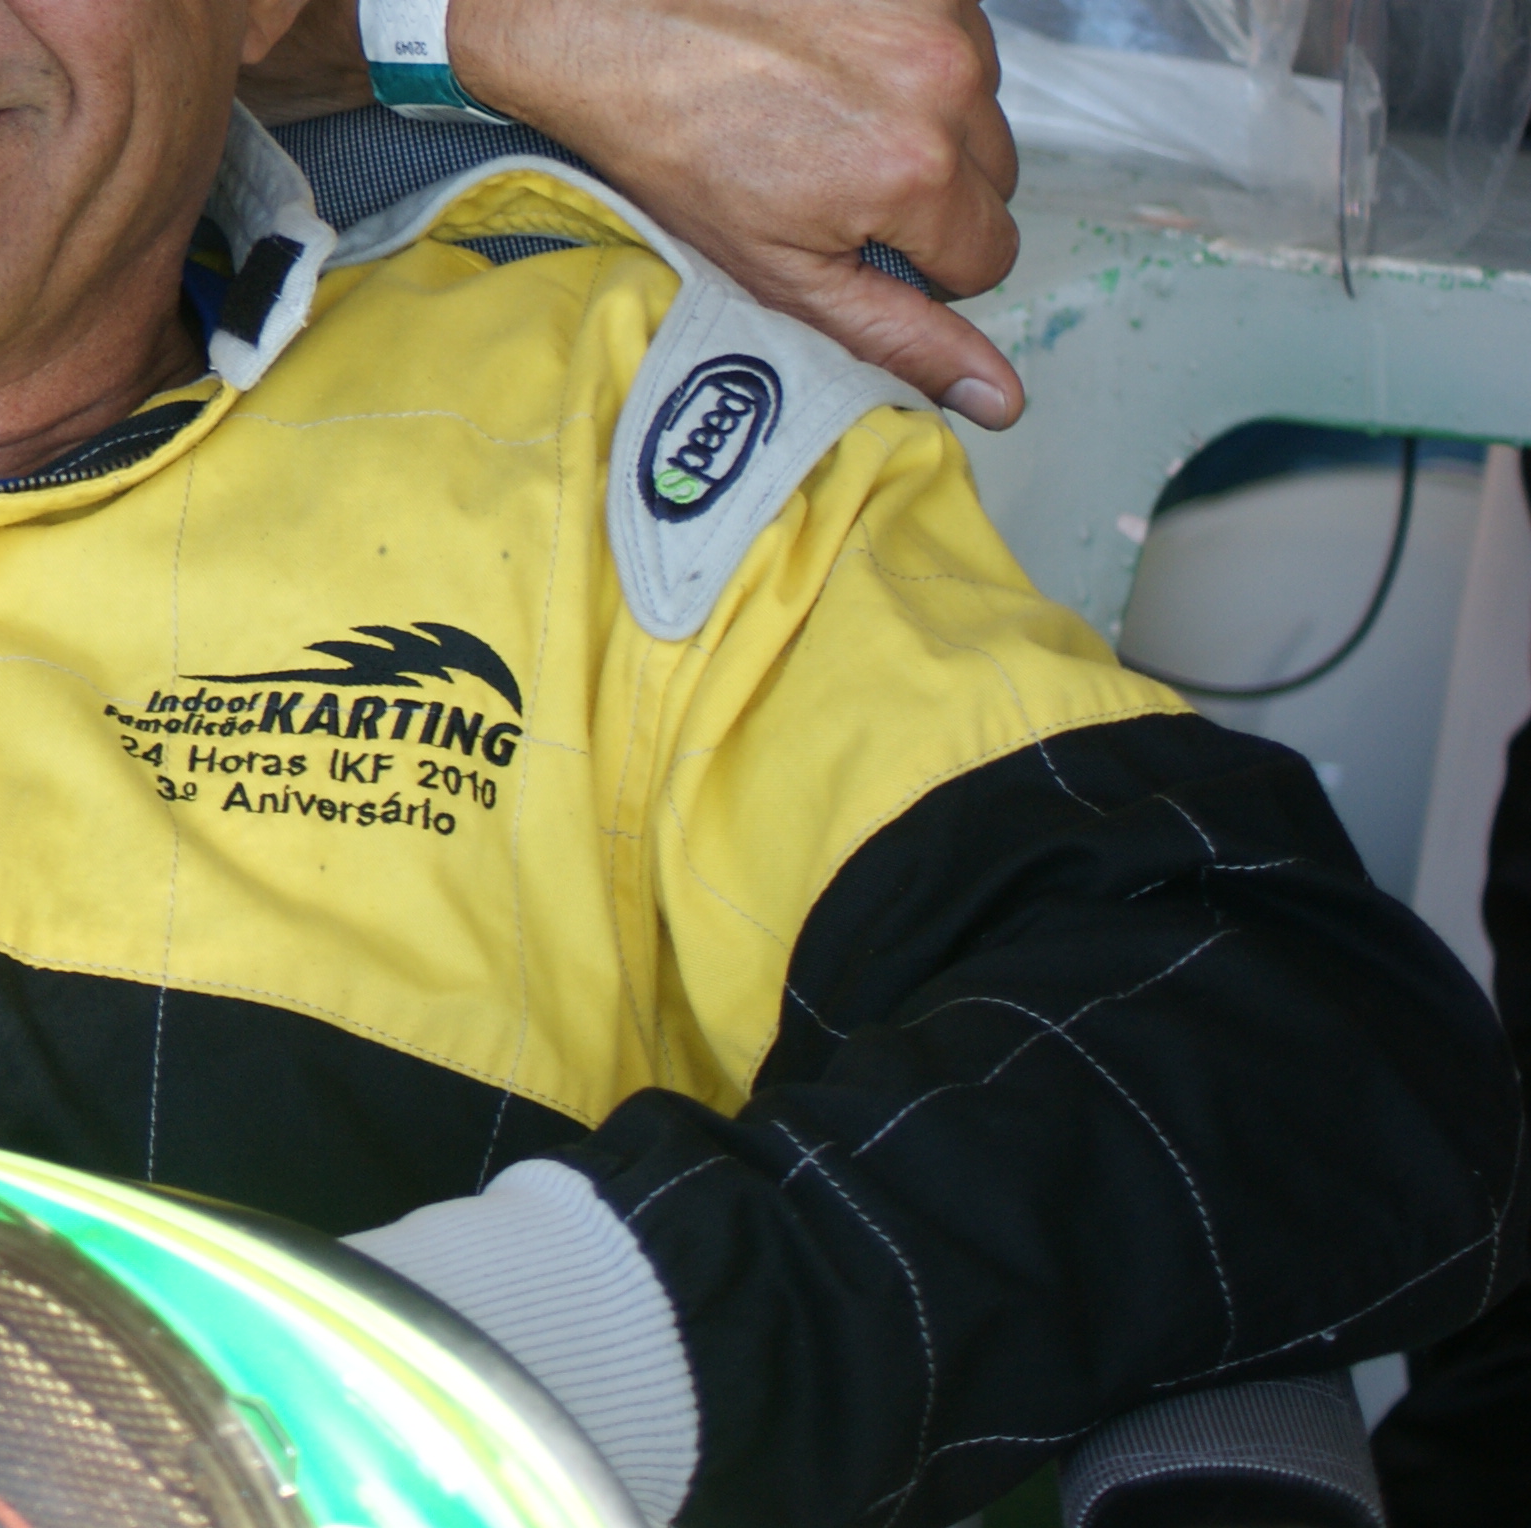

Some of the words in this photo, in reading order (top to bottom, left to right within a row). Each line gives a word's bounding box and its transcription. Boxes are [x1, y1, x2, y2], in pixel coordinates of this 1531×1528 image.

[655, 379, 757, 505] Speed
[145, 687, 263, 713] Indoor
[257, 691, 523, 767] KARTING
[120, 734, 164, 768] 24
[188, 744, 308, 777] Horas
[329, 748, 395, 784] IKF
[417, 759, 497, 810] 2010
[220, 780, 457, 836] Aniversário
